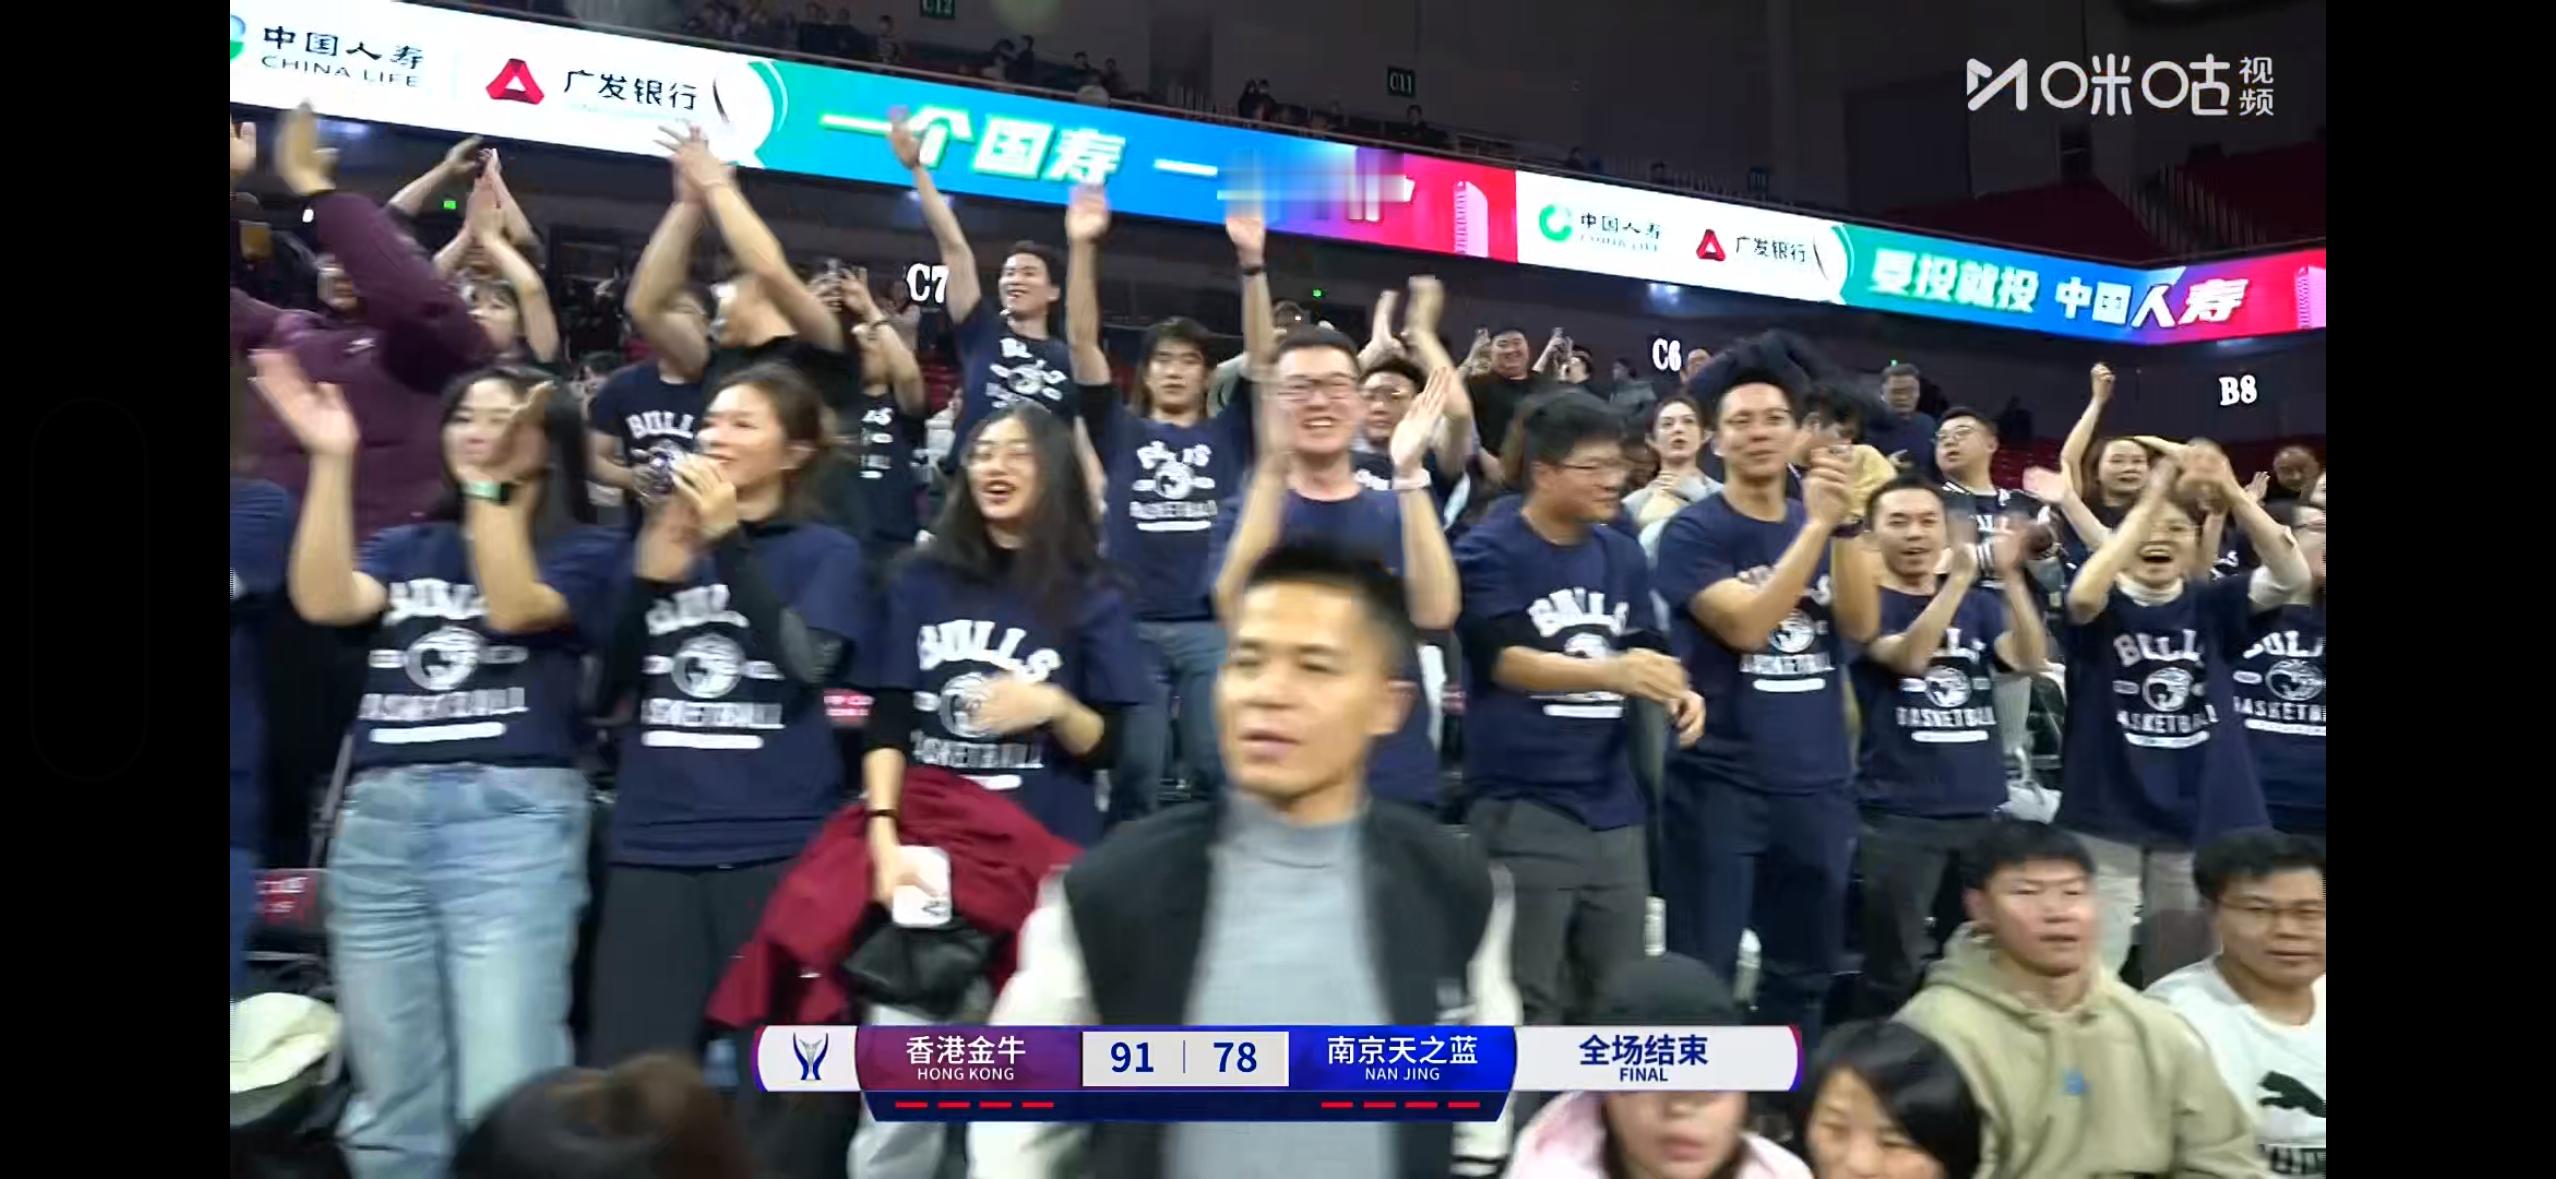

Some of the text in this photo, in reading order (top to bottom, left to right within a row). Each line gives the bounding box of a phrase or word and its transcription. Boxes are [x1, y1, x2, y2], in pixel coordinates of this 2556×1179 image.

[264, 26, 424, 69] 中国人寿
[261, 55, 418, 88] CHINA LIFE
[564, 70, 697, 110] 广发银行
[1736, 235, 1806, 263] 广发银行
[906, 263, 949, 303] C7
[2055, 276, 2248, 328] 中国人寿
[1652, 337, 1682, 371] C6
[2219, 374, 2258, 406] B8
[626, 410, 695, 439] BULL
[917, 619, 1063, 684] BULLS
